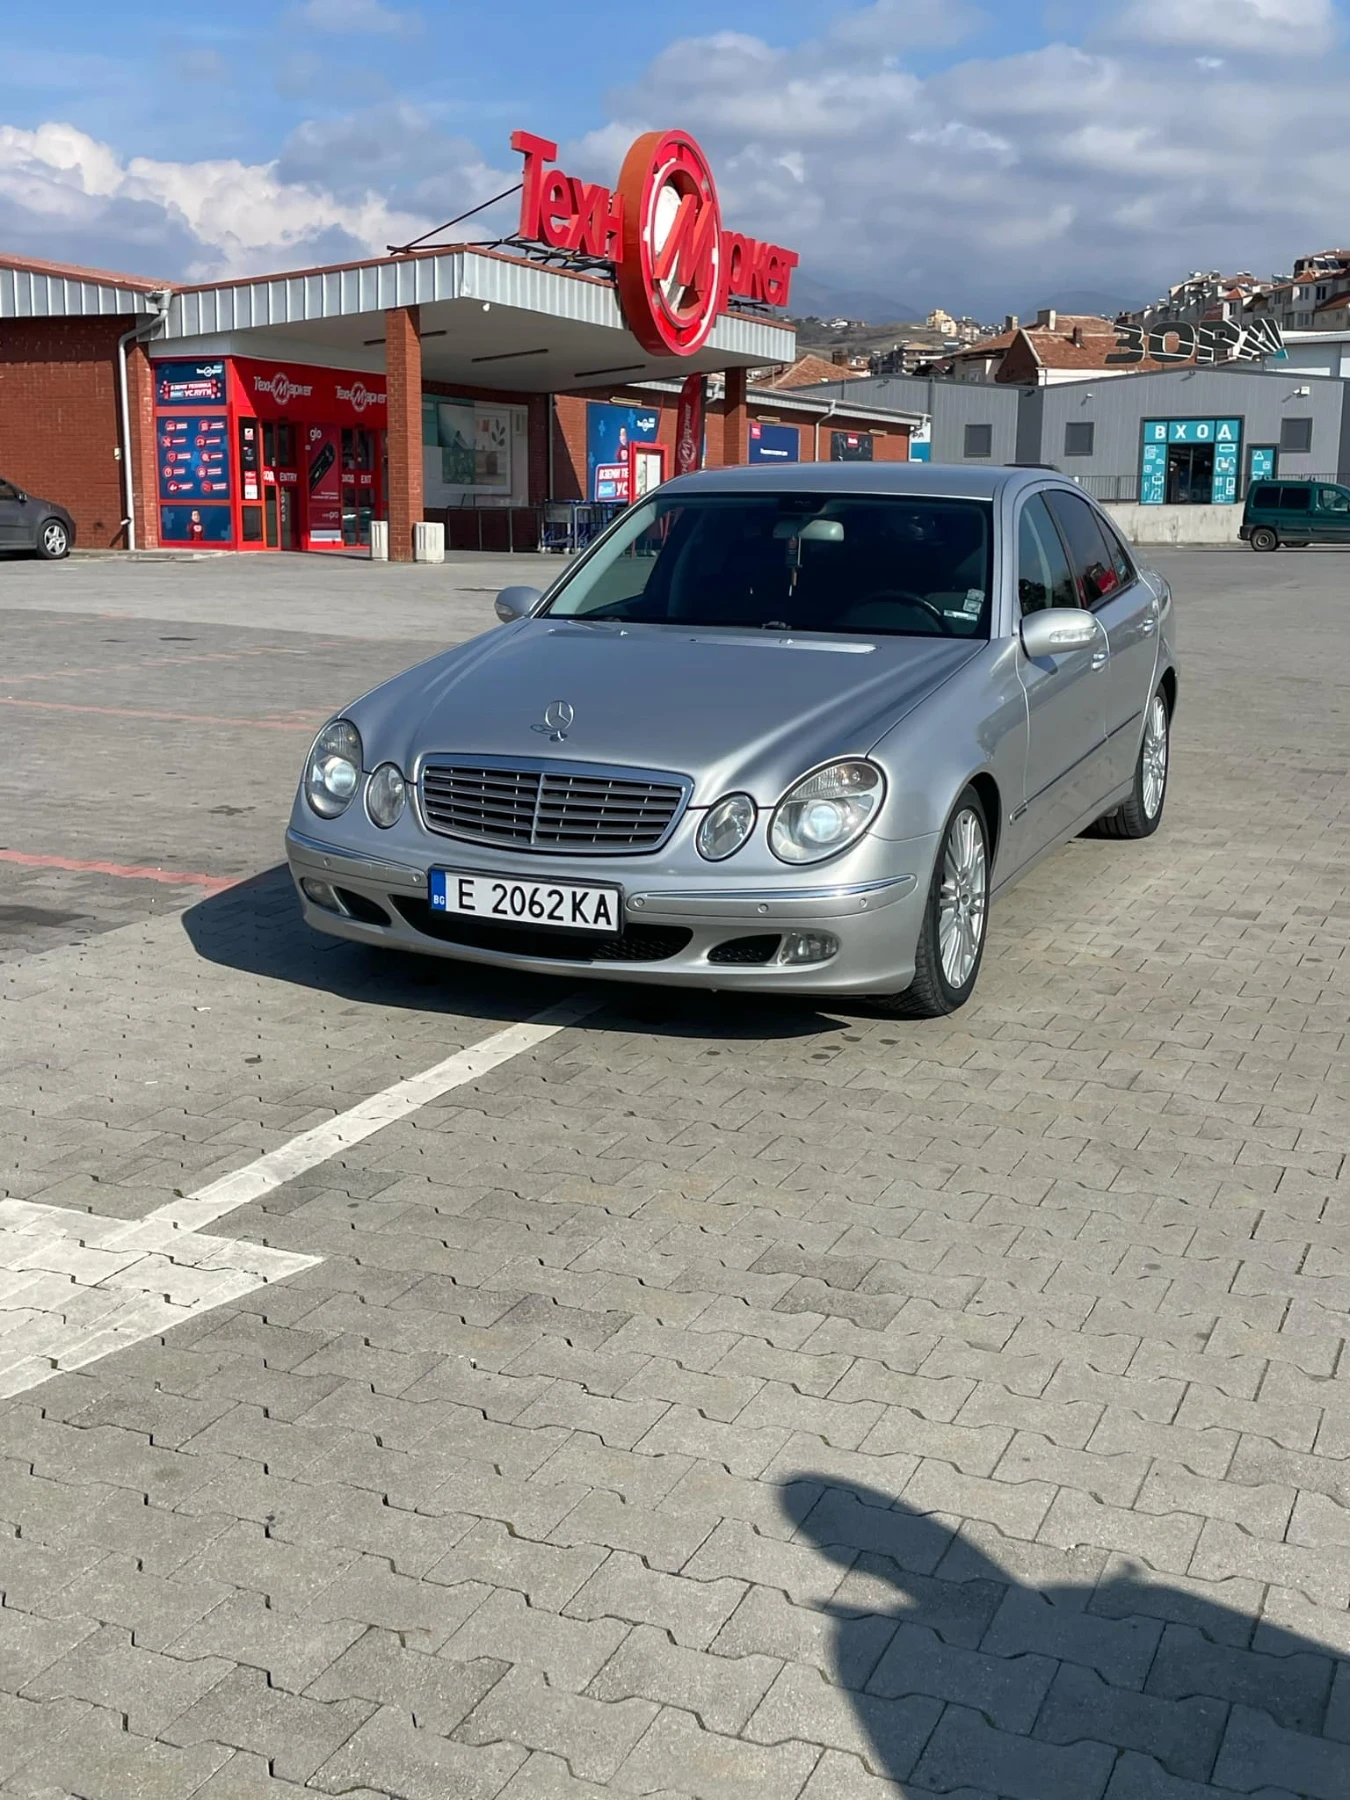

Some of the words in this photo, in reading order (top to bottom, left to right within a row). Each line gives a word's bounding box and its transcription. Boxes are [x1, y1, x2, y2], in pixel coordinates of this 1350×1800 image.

[1104, 317, 1289, 366] ЗОРА
[309, 427, 322, 441] glo
[1154, 423, 1232, 441] ВХОД
[279, 472, 297, 482] ENTRY
[360, 474, 372, 484] EXIT
[433, 894, 445, 905] BG
[458, 878, 475, 911] E
